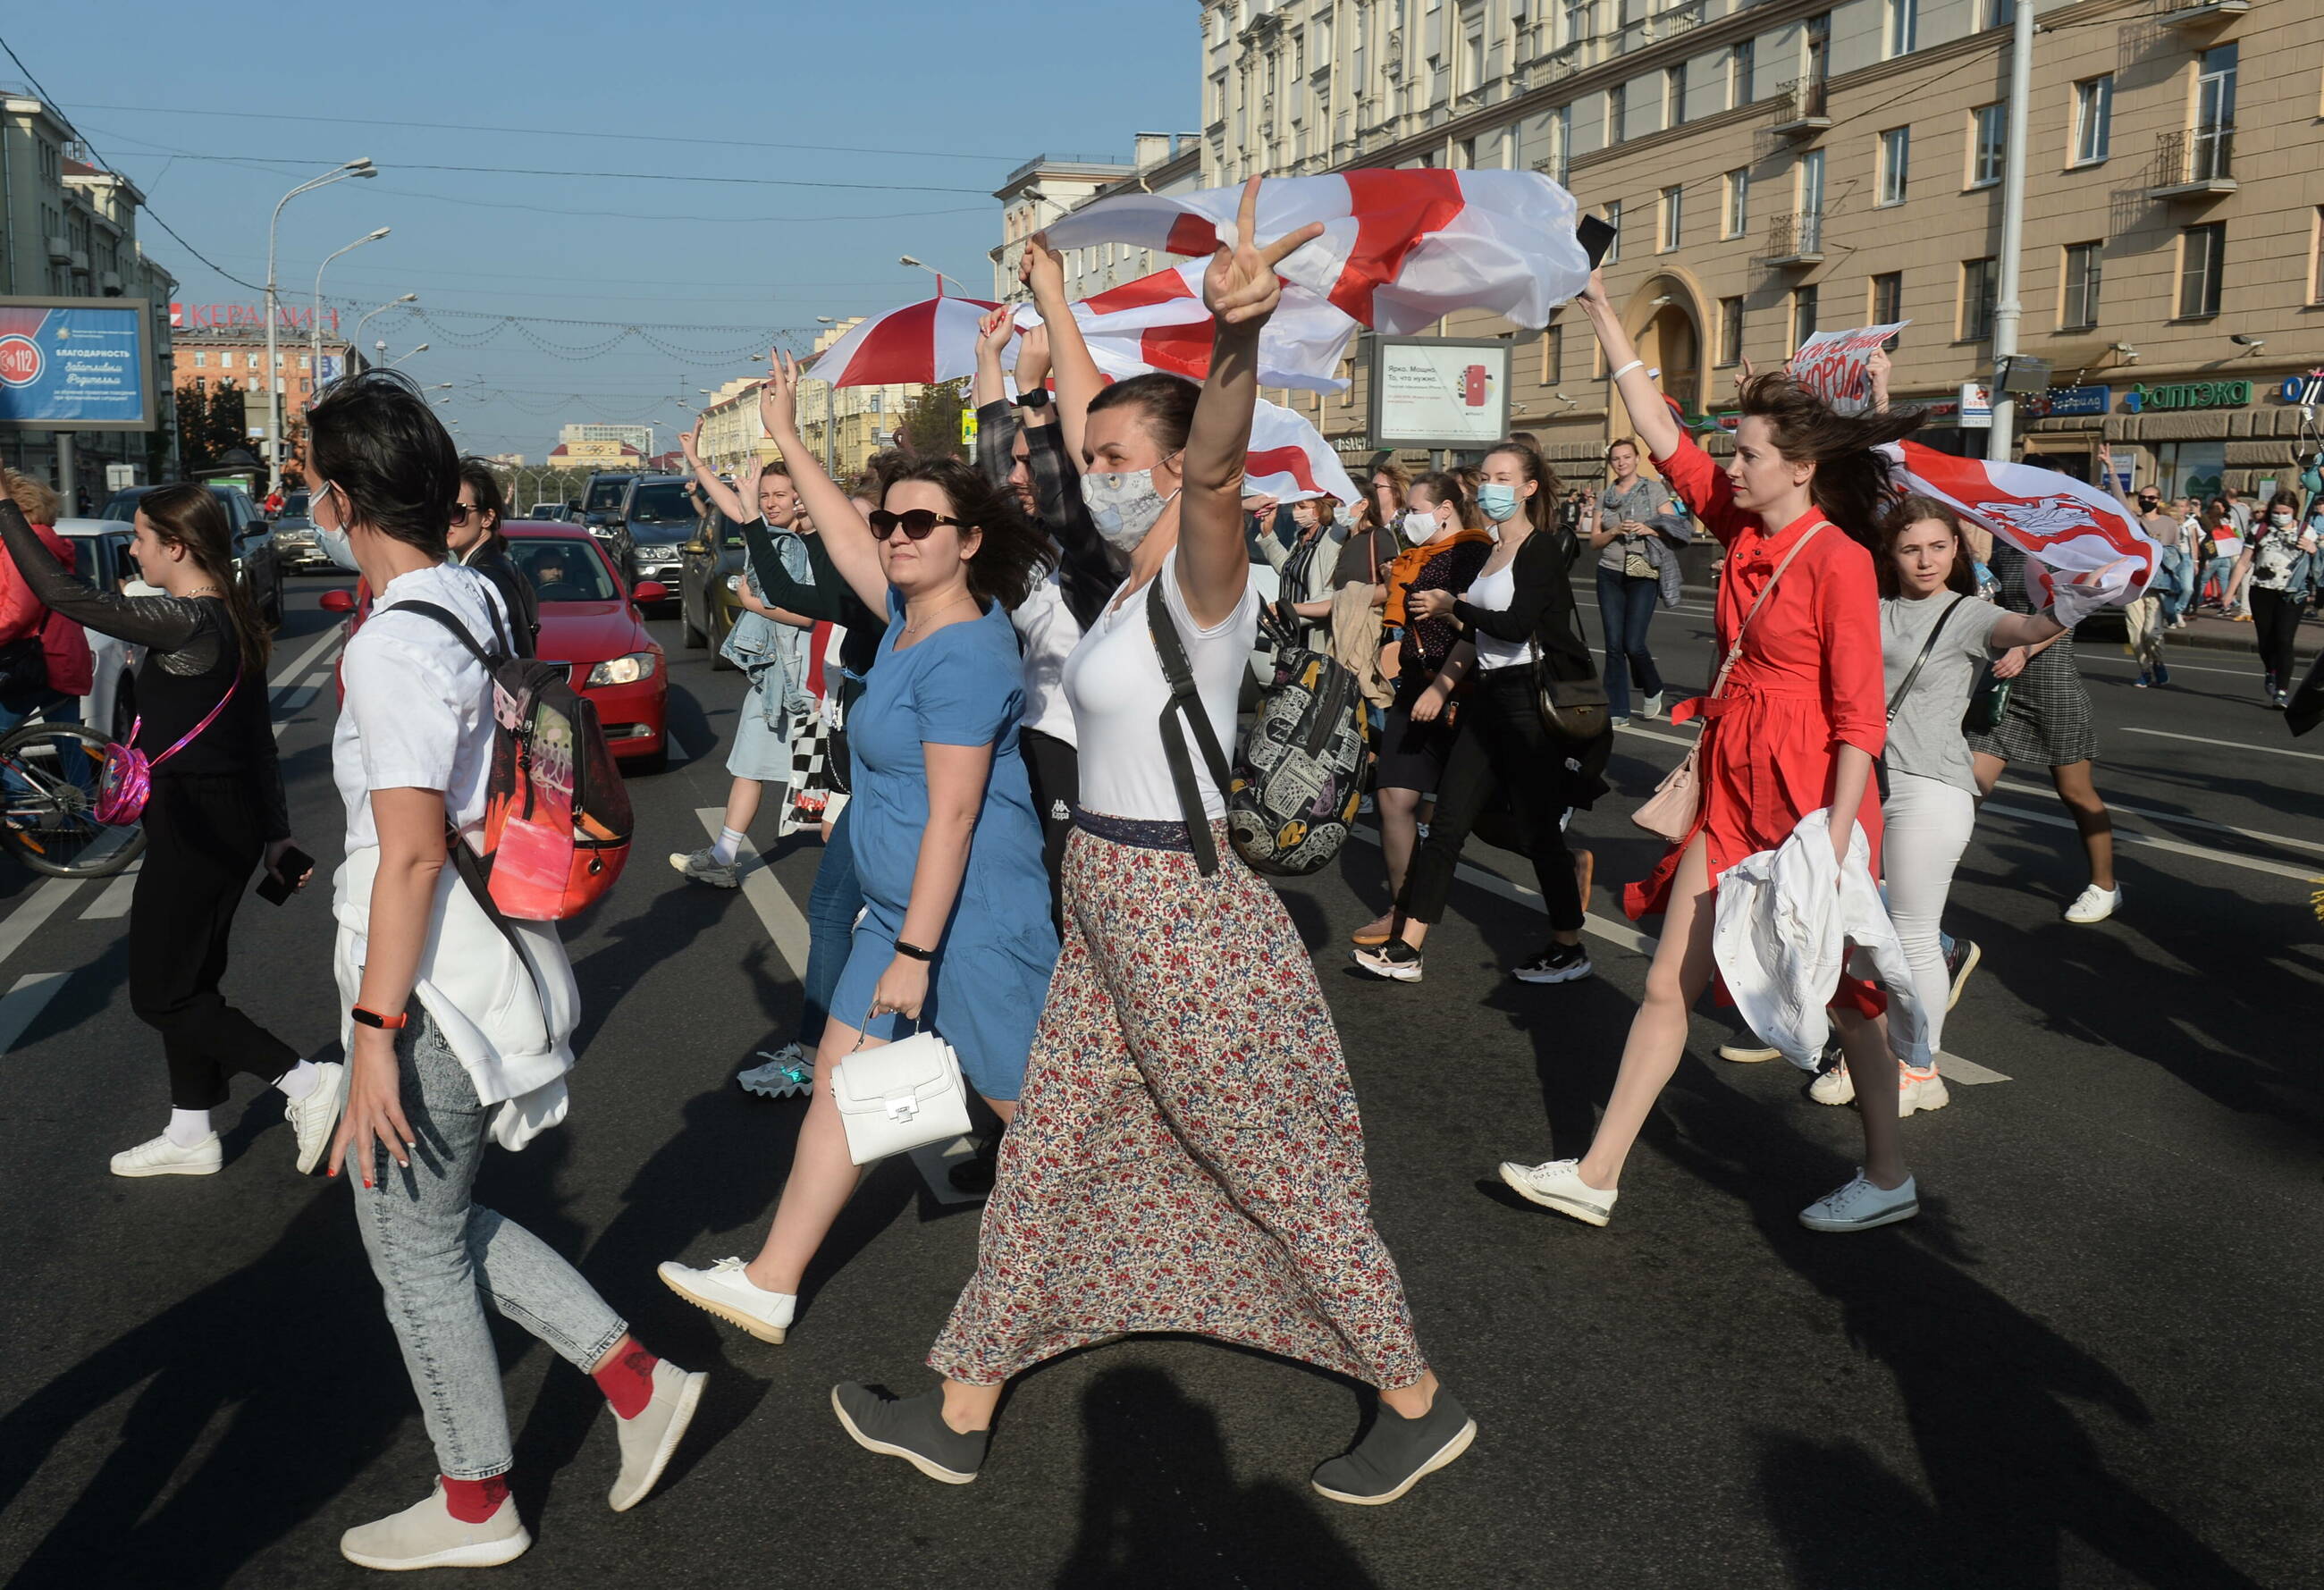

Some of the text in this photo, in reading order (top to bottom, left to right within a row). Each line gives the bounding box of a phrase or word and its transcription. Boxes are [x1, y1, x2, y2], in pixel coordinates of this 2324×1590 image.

[16, 349, 33, 372] 112
[55, 349, 131, 358] БЛАГОДАРНОСТЬ
[2151, 381, 2254, 408] аптэка
